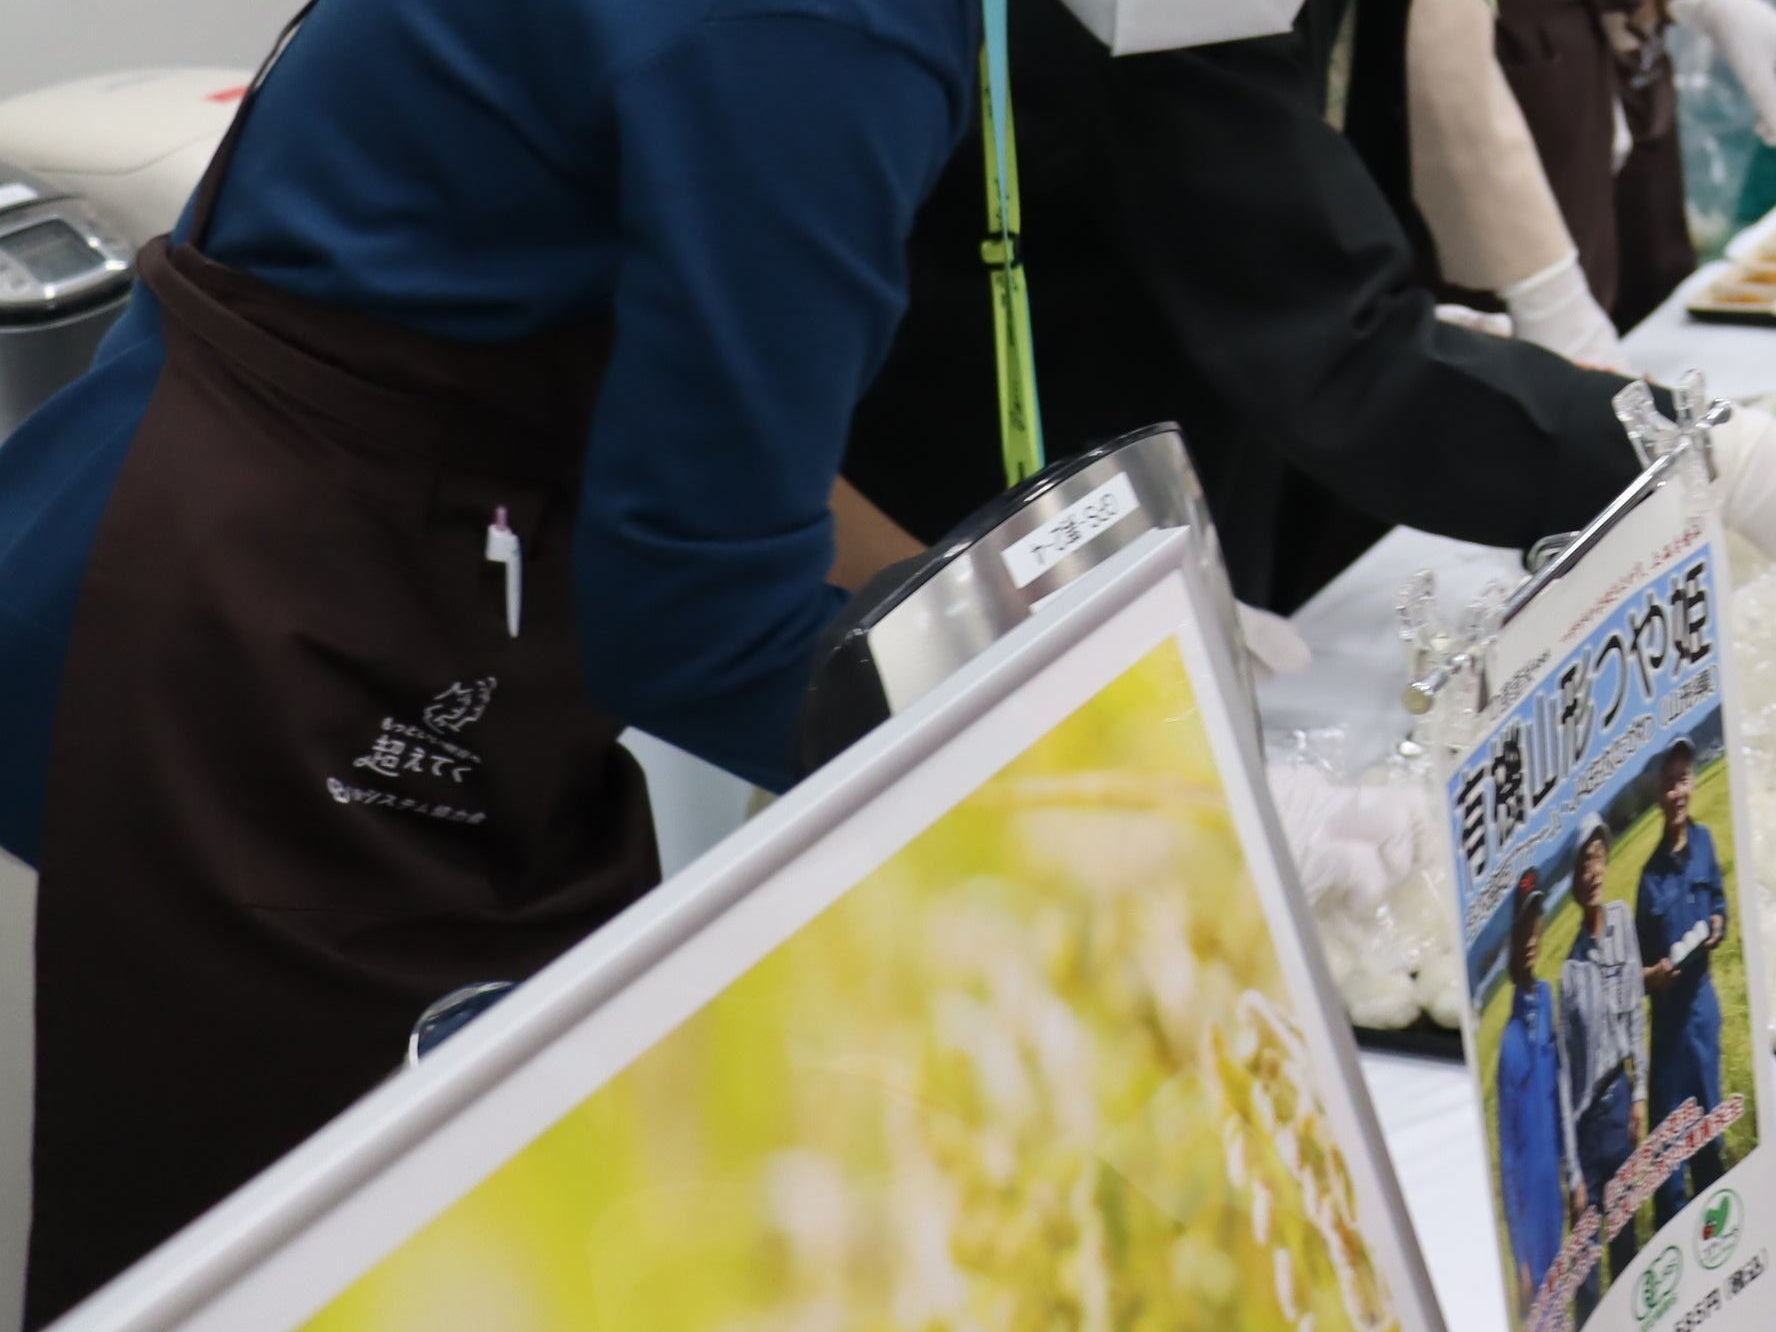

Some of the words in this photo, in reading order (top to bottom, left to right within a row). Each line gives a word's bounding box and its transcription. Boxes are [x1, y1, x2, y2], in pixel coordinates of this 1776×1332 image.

[352, 734, 473, 783] 超えてく
[1454, 558, 1714, 894] 有機山形つや姫
